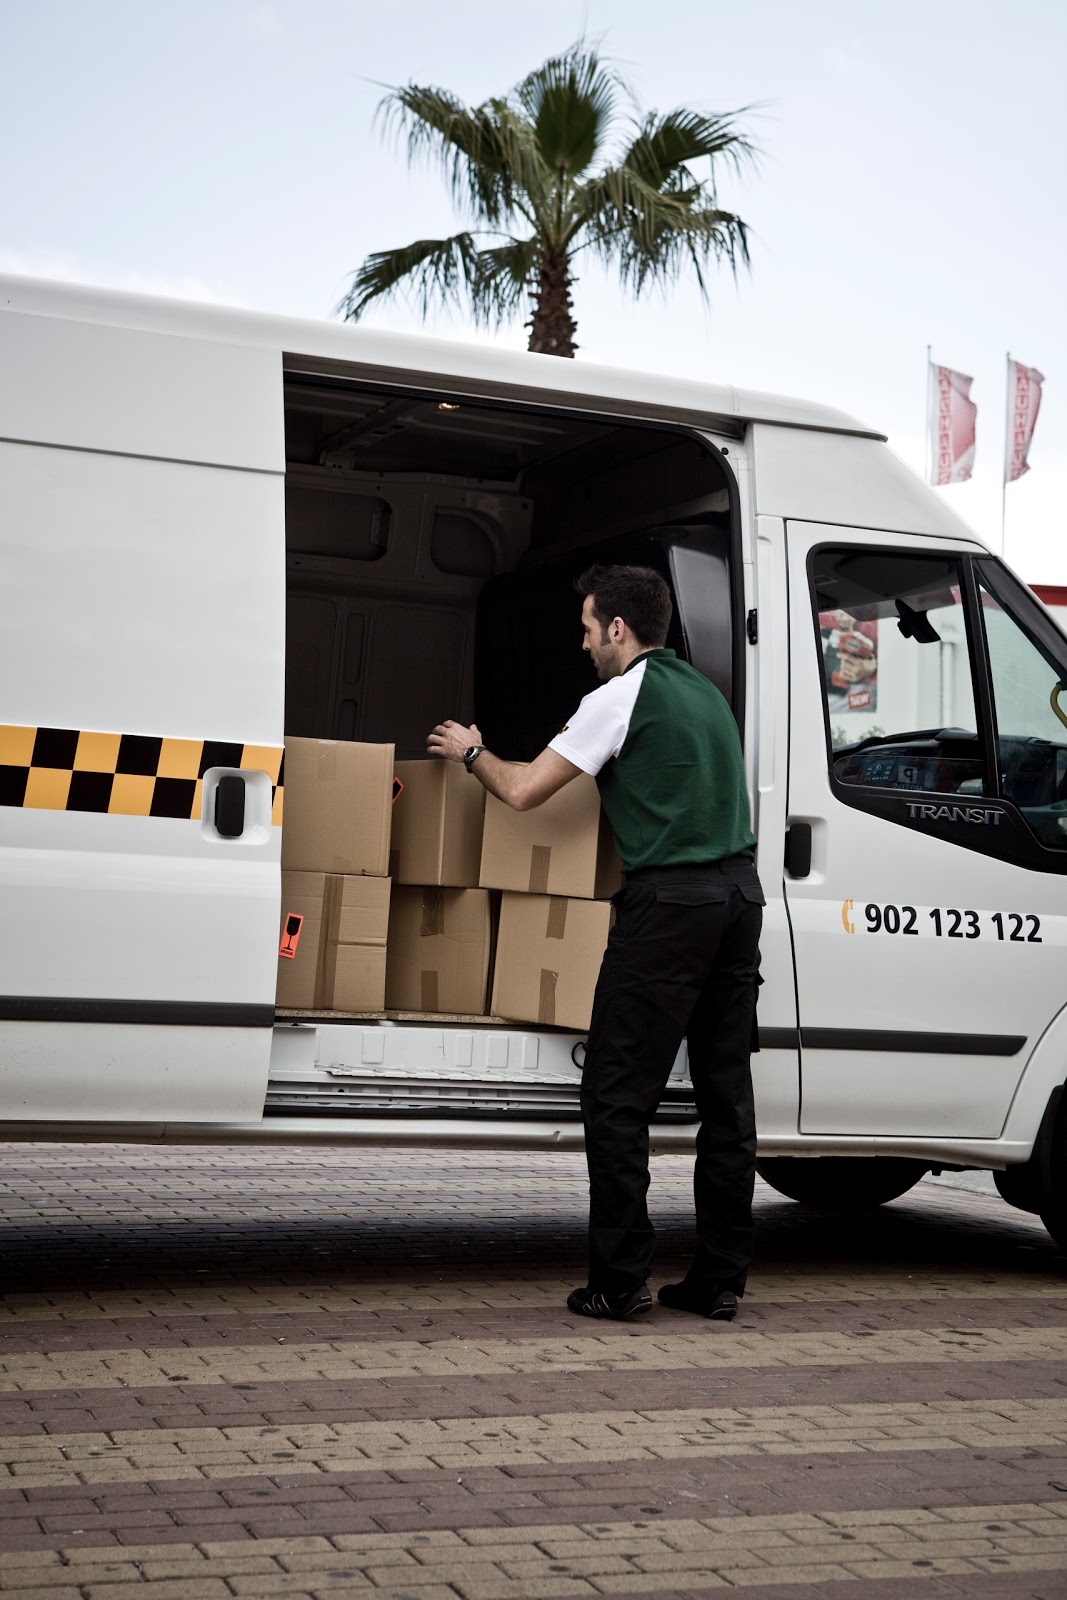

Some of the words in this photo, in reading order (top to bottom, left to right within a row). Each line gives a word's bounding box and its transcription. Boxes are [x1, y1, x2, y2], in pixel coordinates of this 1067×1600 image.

[850, 692, 869, 706] NEW
[906, 803, 1004, 825] TRANSIT
[864, 903, 919, 936] 902
[928, 908, 981, 939] 123
[990, 912, 1043, 943] 122
